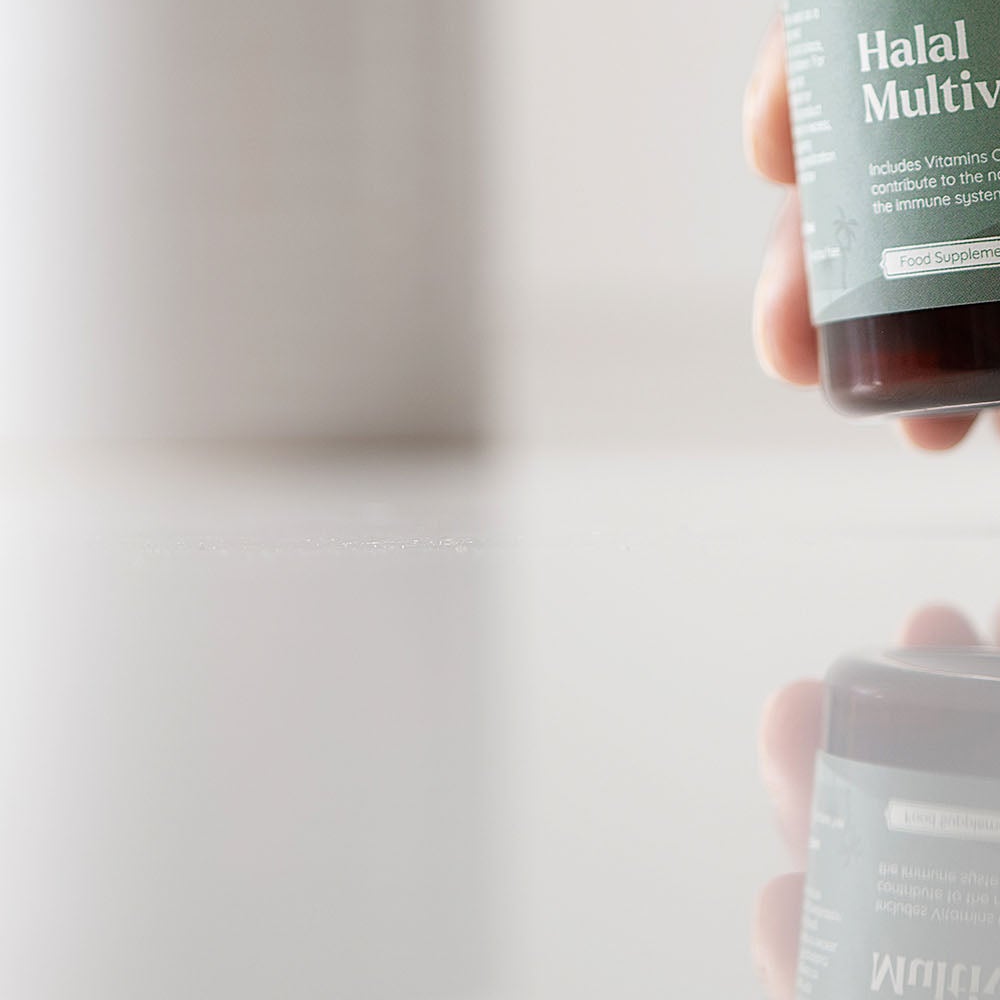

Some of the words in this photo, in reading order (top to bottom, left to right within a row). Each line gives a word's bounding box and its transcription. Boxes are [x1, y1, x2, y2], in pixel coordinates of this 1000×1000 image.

[857, 19, 969, 73] Halal
[868, 159, 921, 176] Includes
[924, 151, 987, 169] Vitamins
[871, 177, 937, 195] contribute
[941, 174, 956, 187] to
[960, 171, 983, 185] the
[872, 200, 893, 214] the
[896, 195, 951, 211] immune
[900, 255, 931, 267] Food
